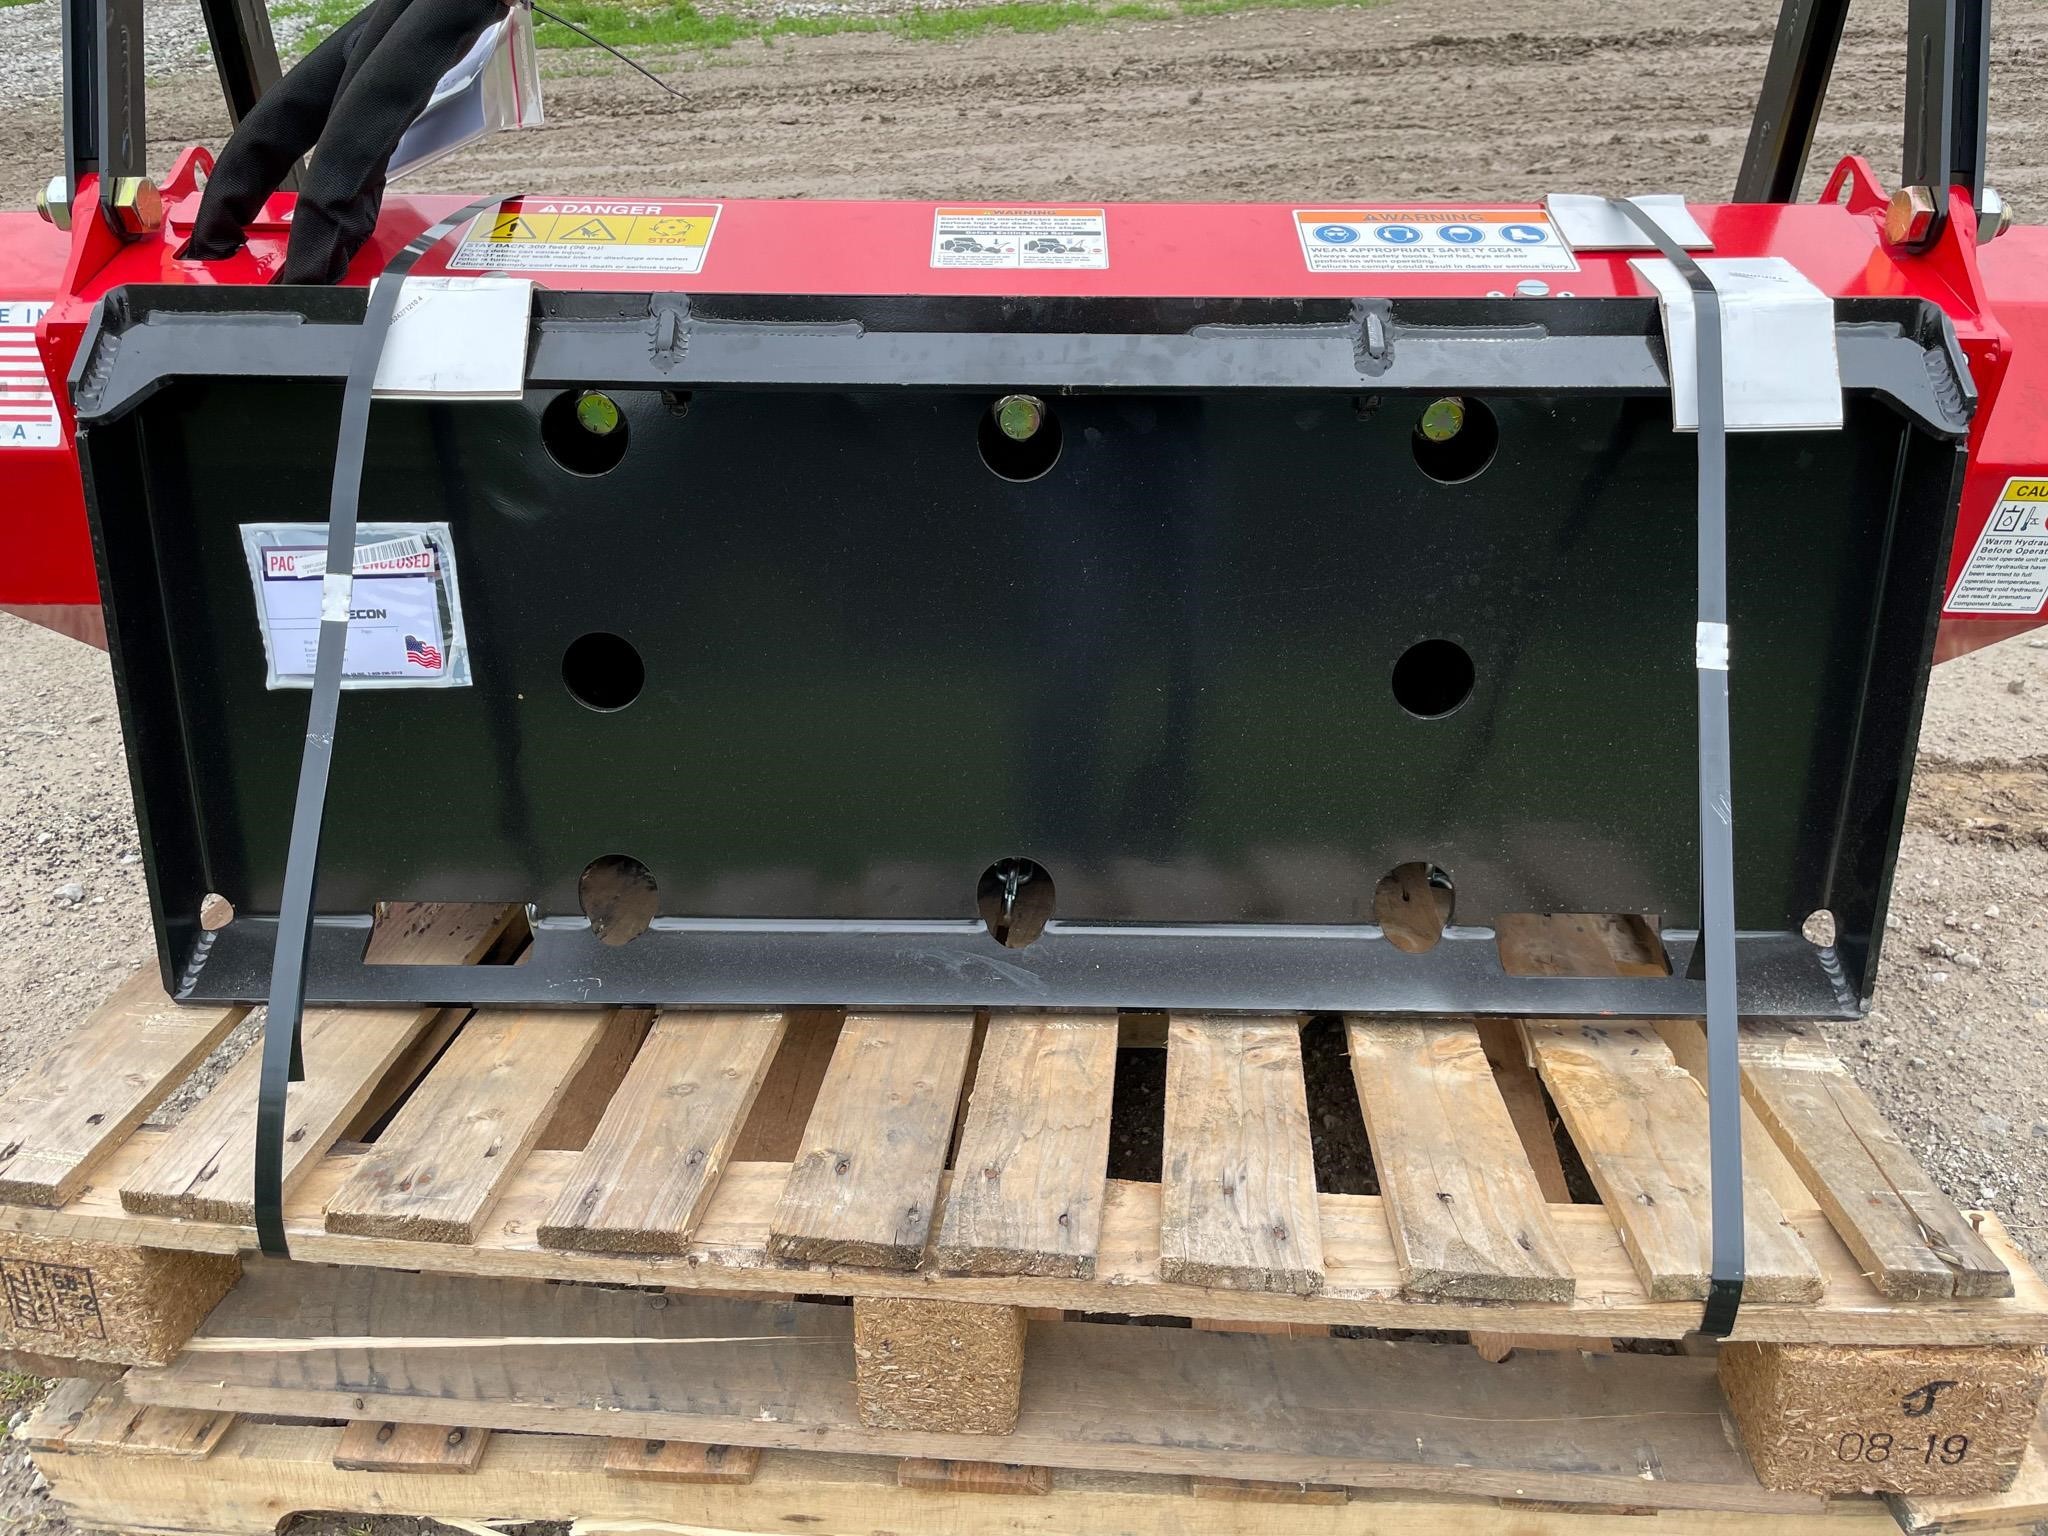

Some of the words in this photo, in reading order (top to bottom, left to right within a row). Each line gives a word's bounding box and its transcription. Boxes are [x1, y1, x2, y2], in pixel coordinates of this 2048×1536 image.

[561, 204, 662, 215] DANGER
[1376, 213, 1484, 222] WARNING
[1985, 537, 2012, 545] Warm
[1980, 546, 2013, 554] Before
[349, 608, 387, 619] ECON
[1838, 1432, 1968, 1465] 08-19
